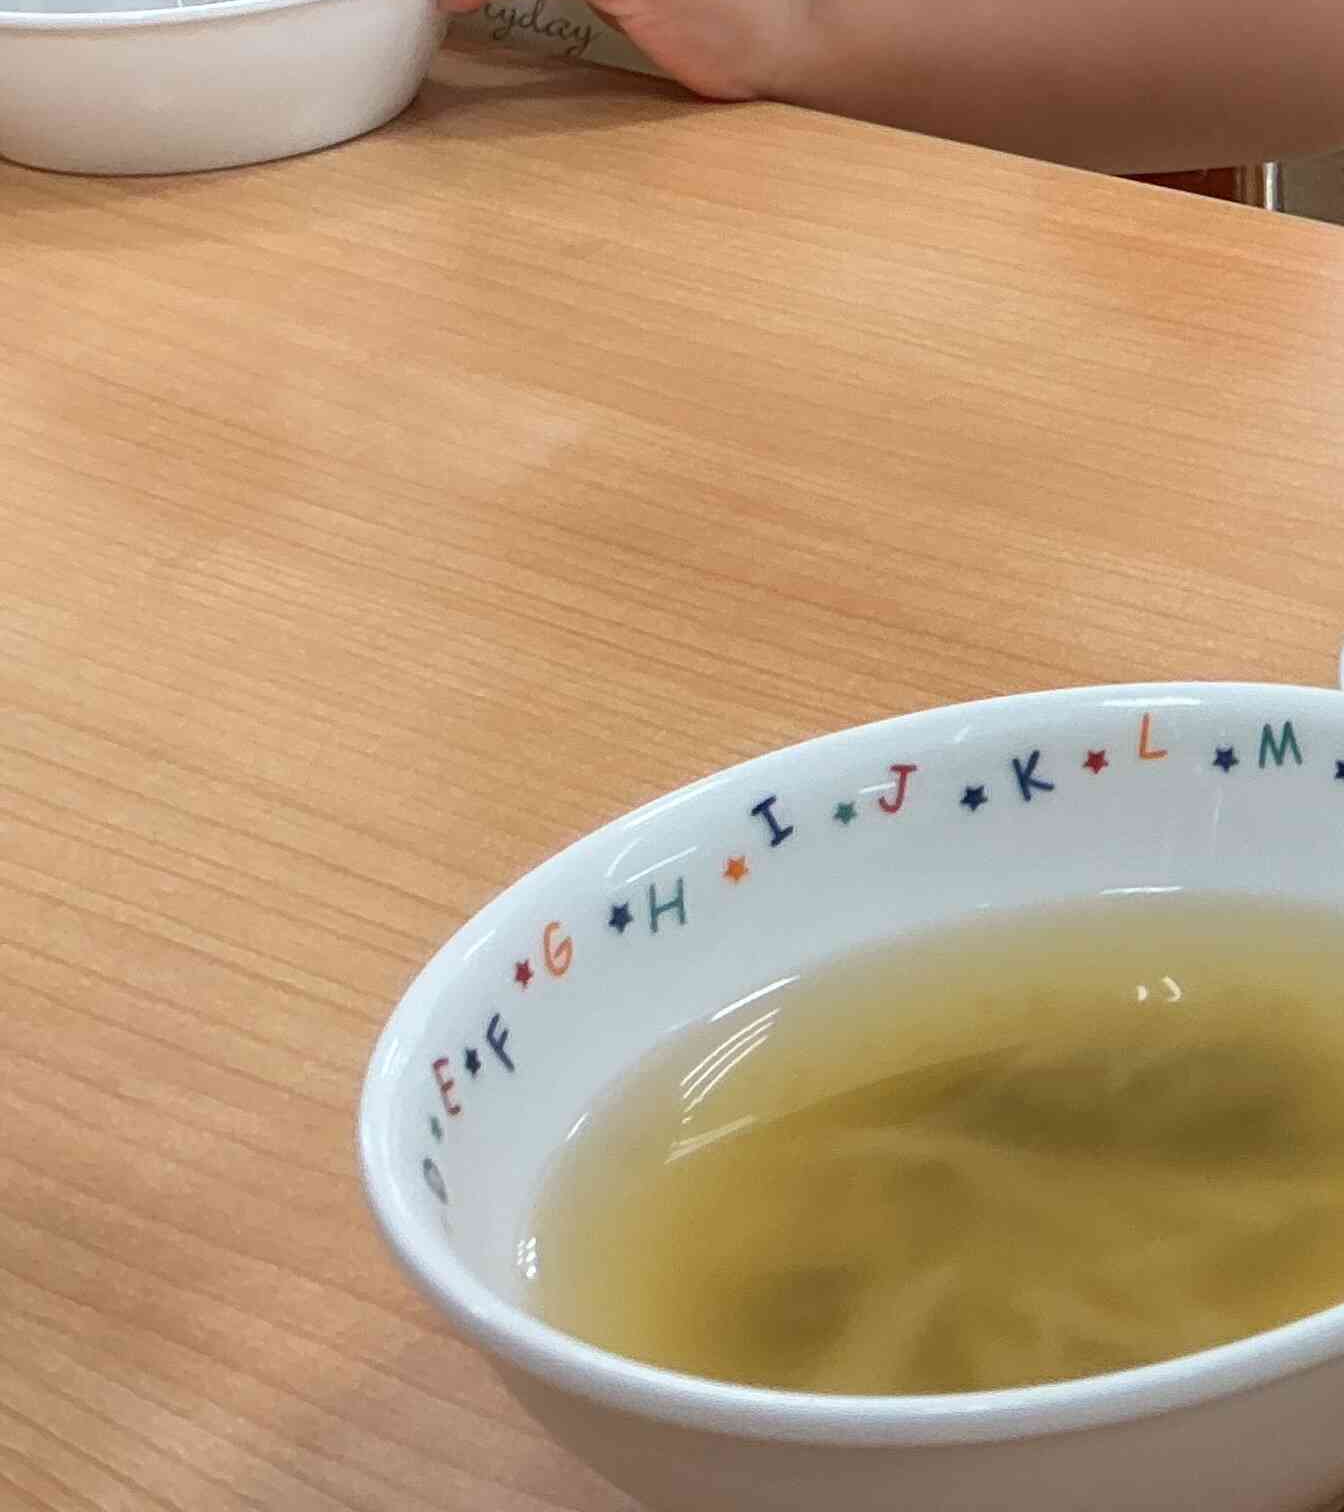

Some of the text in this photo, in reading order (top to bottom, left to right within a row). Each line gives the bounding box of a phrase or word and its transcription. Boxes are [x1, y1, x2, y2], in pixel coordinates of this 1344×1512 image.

[431, 1056, 462, 1117] E
[485, 1012, 516, 1073] F
[542, 921, 574, 977] G
[648, 877, 687, 934] H
[750, 795, 795, 848] I
[878, 763, 918, 814] J
[1011, 749, 1055, 802] K
[1138, 711, 1169, 762] L
[1258, 720, 1303, 770] M
